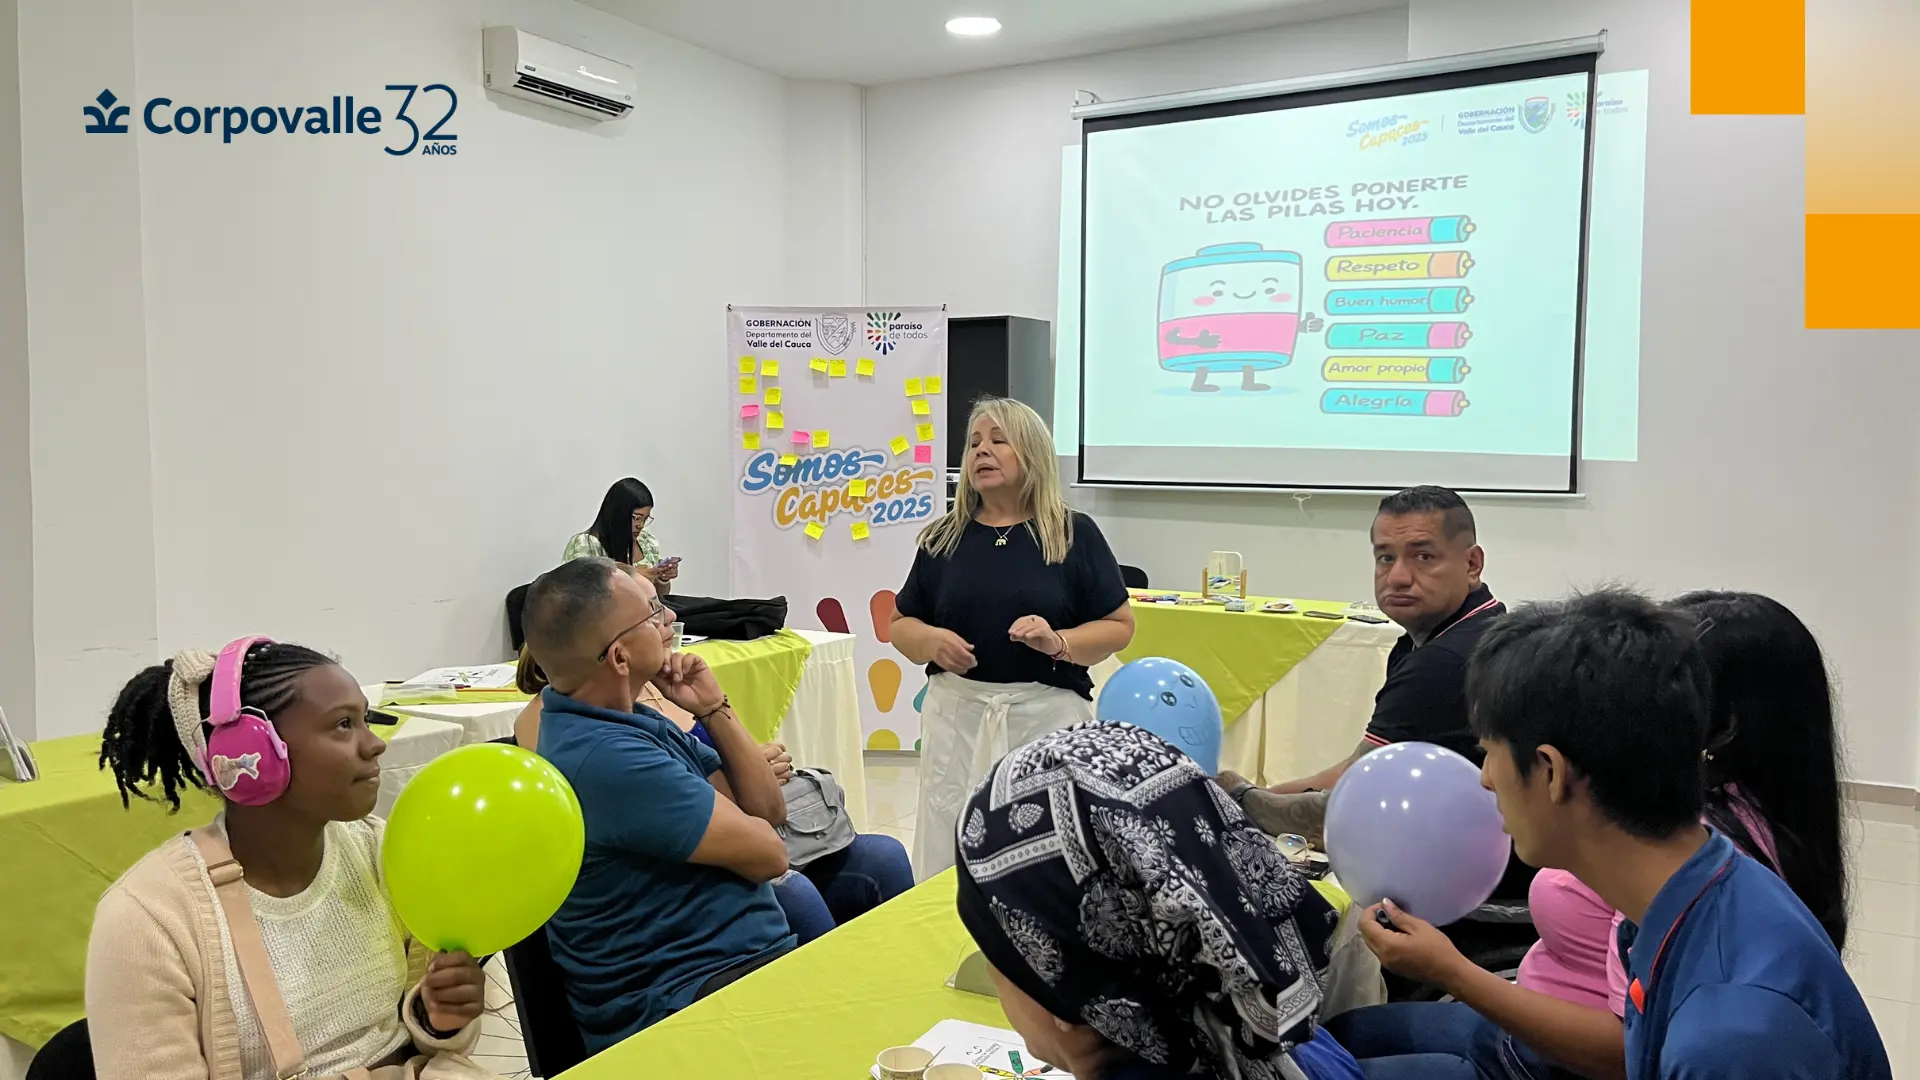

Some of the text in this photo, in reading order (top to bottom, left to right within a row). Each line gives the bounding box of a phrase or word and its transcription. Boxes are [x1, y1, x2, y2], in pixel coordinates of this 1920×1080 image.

[1346, 114, 1408, 138] Somos
[1477, 125, 1489, 133] del
[1179, 175, 1469, 211] NO OLVIDES PONERTE
[1206, 195, 1420, 224] LAS PILAS HOY.
[1337, 224, 1424, 240] Paciencia
[1336, 259, 1420, 275] Respeto
[1335, 295, 1429, 308] Buen humor
[746, 317, 812, 328] GOBERNACIÓN
[889, 321, 923, 332] paraíso
[746, 330, 812, 339] Departamento del
[889, 331, 928, 340] de todos
[1359, 328, 1405, 342] Paz
[747, 339, 812, 348] Valle del Cauca
[1328, 362, 1426, 375] Amor propio
[1334, 393, 1413, 410] Alegría
[743, 451, 885, 491] Somos
[872, 495, 932, 523] 2025
